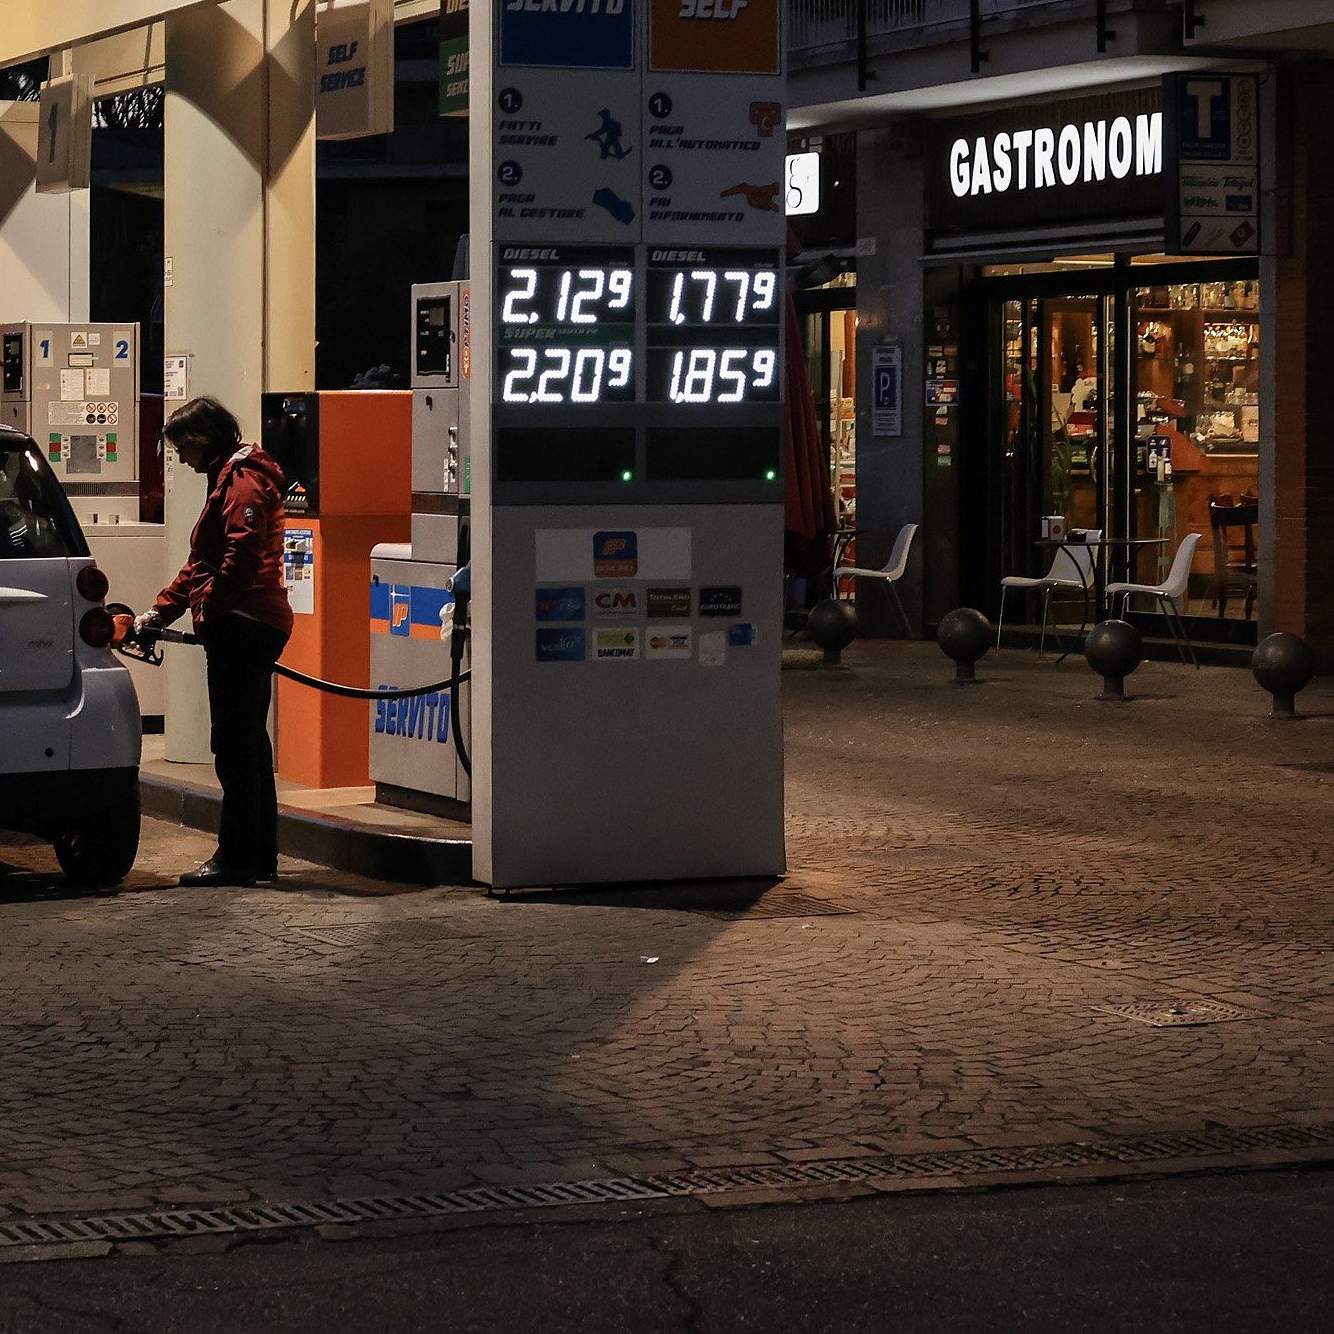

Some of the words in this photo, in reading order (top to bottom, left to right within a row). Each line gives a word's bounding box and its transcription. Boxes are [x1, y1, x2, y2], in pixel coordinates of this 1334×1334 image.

[328, 41, 359, 65] SELF
[320, 66, 366, 93] SERVICE
[1186, 80, 1224, 139] T
[499, 121, 542, 131] FATTI
[649, 125, 684, 135] PAGA
[499, 135, 559, 145] SERVIRE
[649, 138, 761, 150] ALL'AUTOMATICO
[950, 112, 1162, 197] GASTRONOM
[498, 193, 535, 203] PAGA
[650, 197, 671, 207] FAI
[498, 207, 515, 217] AL
[519, 207, 585, 218] GESTORE
[503, 248, 560, 260] DIESEL
[651, 250, 706, 262] DIESEL
[504, 328, 557, 339] SUPER
[40, 339, 50, 358] 1
[115, 340, 128, 358] 2
[375, 685, 450, 743] SERVITO
